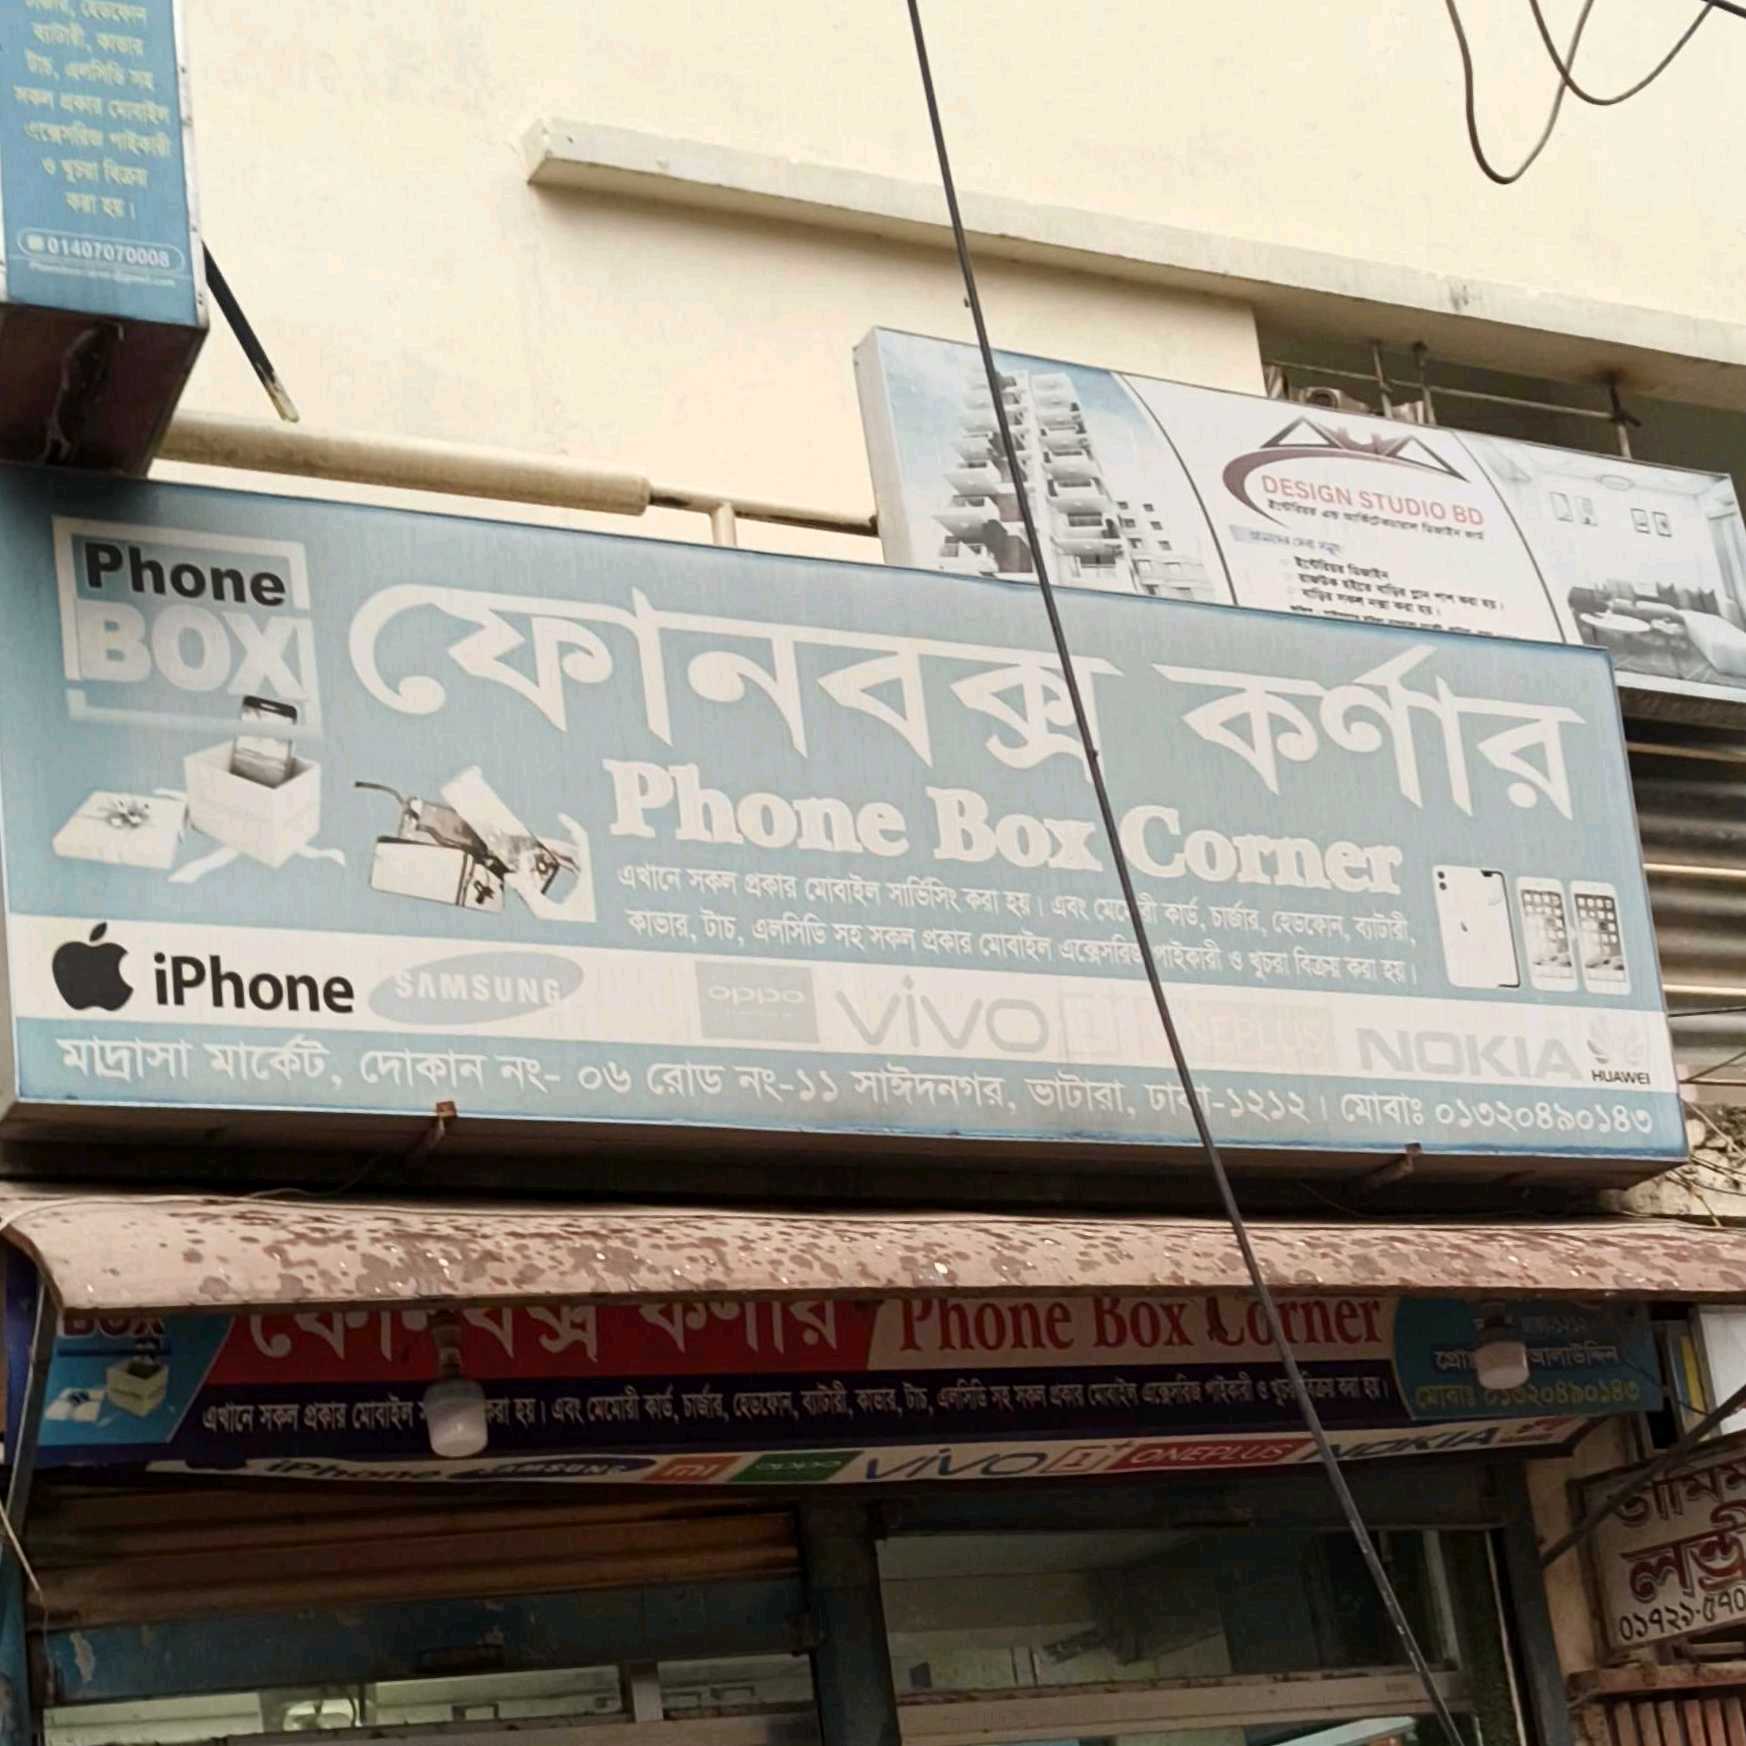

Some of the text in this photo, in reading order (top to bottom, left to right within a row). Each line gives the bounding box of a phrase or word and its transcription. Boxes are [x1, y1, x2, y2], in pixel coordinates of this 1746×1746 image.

[1261, 474, 1485, 527] DESIGN STUDIO BD
[83, 541, 287, 607] Phone
[76, 598, 311, 702] BOX
[1151, 643, 1588, 822] কর্ণার
[601, 758, 1404, 896] Phone Box Corner
[617, 862, 682, 892] এখানে
[686, 868, 738, 896] সকল
[744, 873, 798, 900] প্রকার
[804, 872, 881, 907] মোবাইল
[959, 888, 1000, 915] করা
[1050, 895, 1089, 921] এবং
[624, 908, 698, 944] কাভার,
[752, 910, 828, 946] এলসিডি
[831, 922, 867, 950] সহ
[866, 924, 917, 952] সকল
[920, 928, 973, 956] প্রকার
[979, 929, 1053, 964] মোবাইল
[1228, 950, 1244, 972] ও
[1343, 956, 1378, 981] করা
[152, 951, 356, 1015] iPhone
[394, 968, 562, 1007] SAMSUNG
[1354, 1026, 1583, 1080] NOKIA
[1590, 1068, 1652, 1086] HUAWEI
[55, 1034, 192, 1081] মাদ্রাসা
[204, 1033, 344, 1091] মার্কেট,
[360, 1047, 489, 1090] দোকান
[577, 1059, 633, 1096] ০৬
[646, 1058, 725, 1097] রোড
[734, 1064, 840, 1104] নং-১১
[1025, 1068, 1137, 1119] ভাটারা,
[1340, 1090, 1424, 1127] মোবাঃ
[1434, 1100, 1655, 1136] ০১৩২০৪৯০১৪৩
[900, 1296, 1385, 1352] Phone Box Corner
[202, 1404, 256, 1433] এখানে
[258, 1403, 299, 1432] সকল
[302, 1402, 348, 1432] প্রকার
[351, 1394, 415, 1432] মোবাইল
[551, 1397, 585, 1426] এবং
[264, 1458, 442, 1480] iPhone
[1129, 1442, 1294, 1466] ONEPLUS
